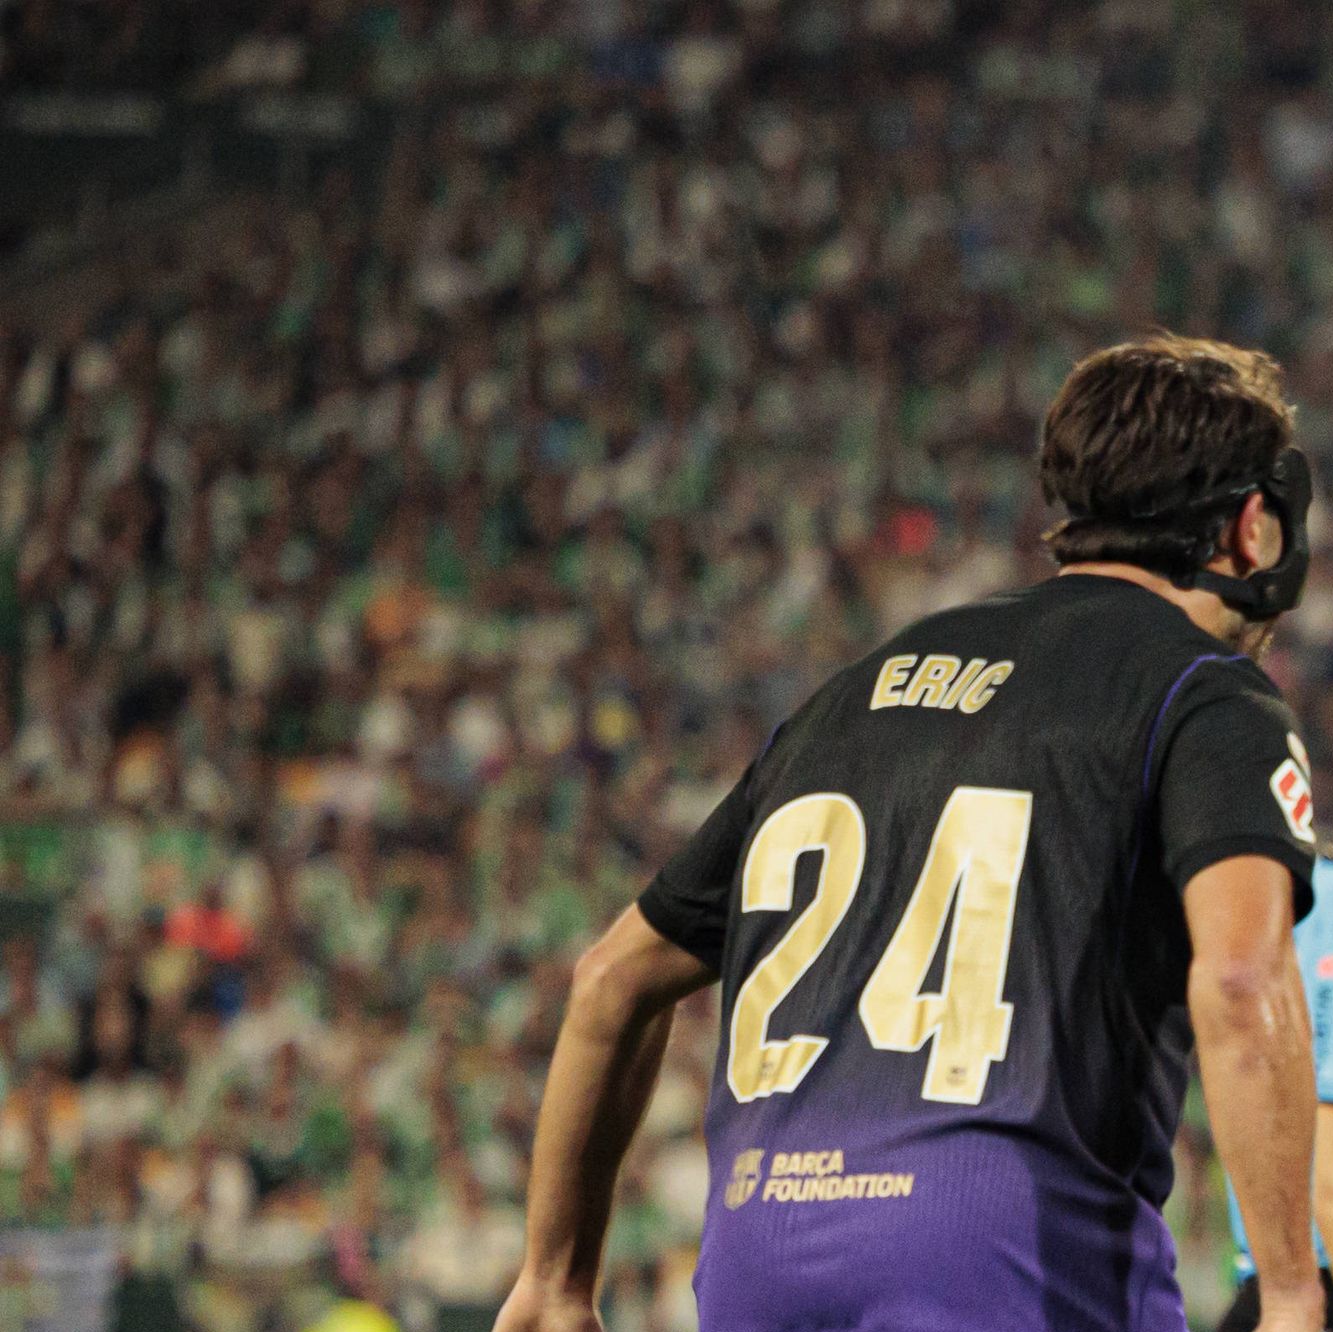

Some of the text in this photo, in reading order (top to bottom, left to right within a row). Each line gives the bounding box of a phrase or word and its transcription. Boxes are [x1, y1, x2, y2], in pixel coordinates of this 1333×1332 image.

[870, 653, 1015, 714] ERIC
[727, 786, 1032, 1104] 24
[770, 1150, 845, 1178] BARÇA
[762, 1172, 915, 1203] FOUNDATION
